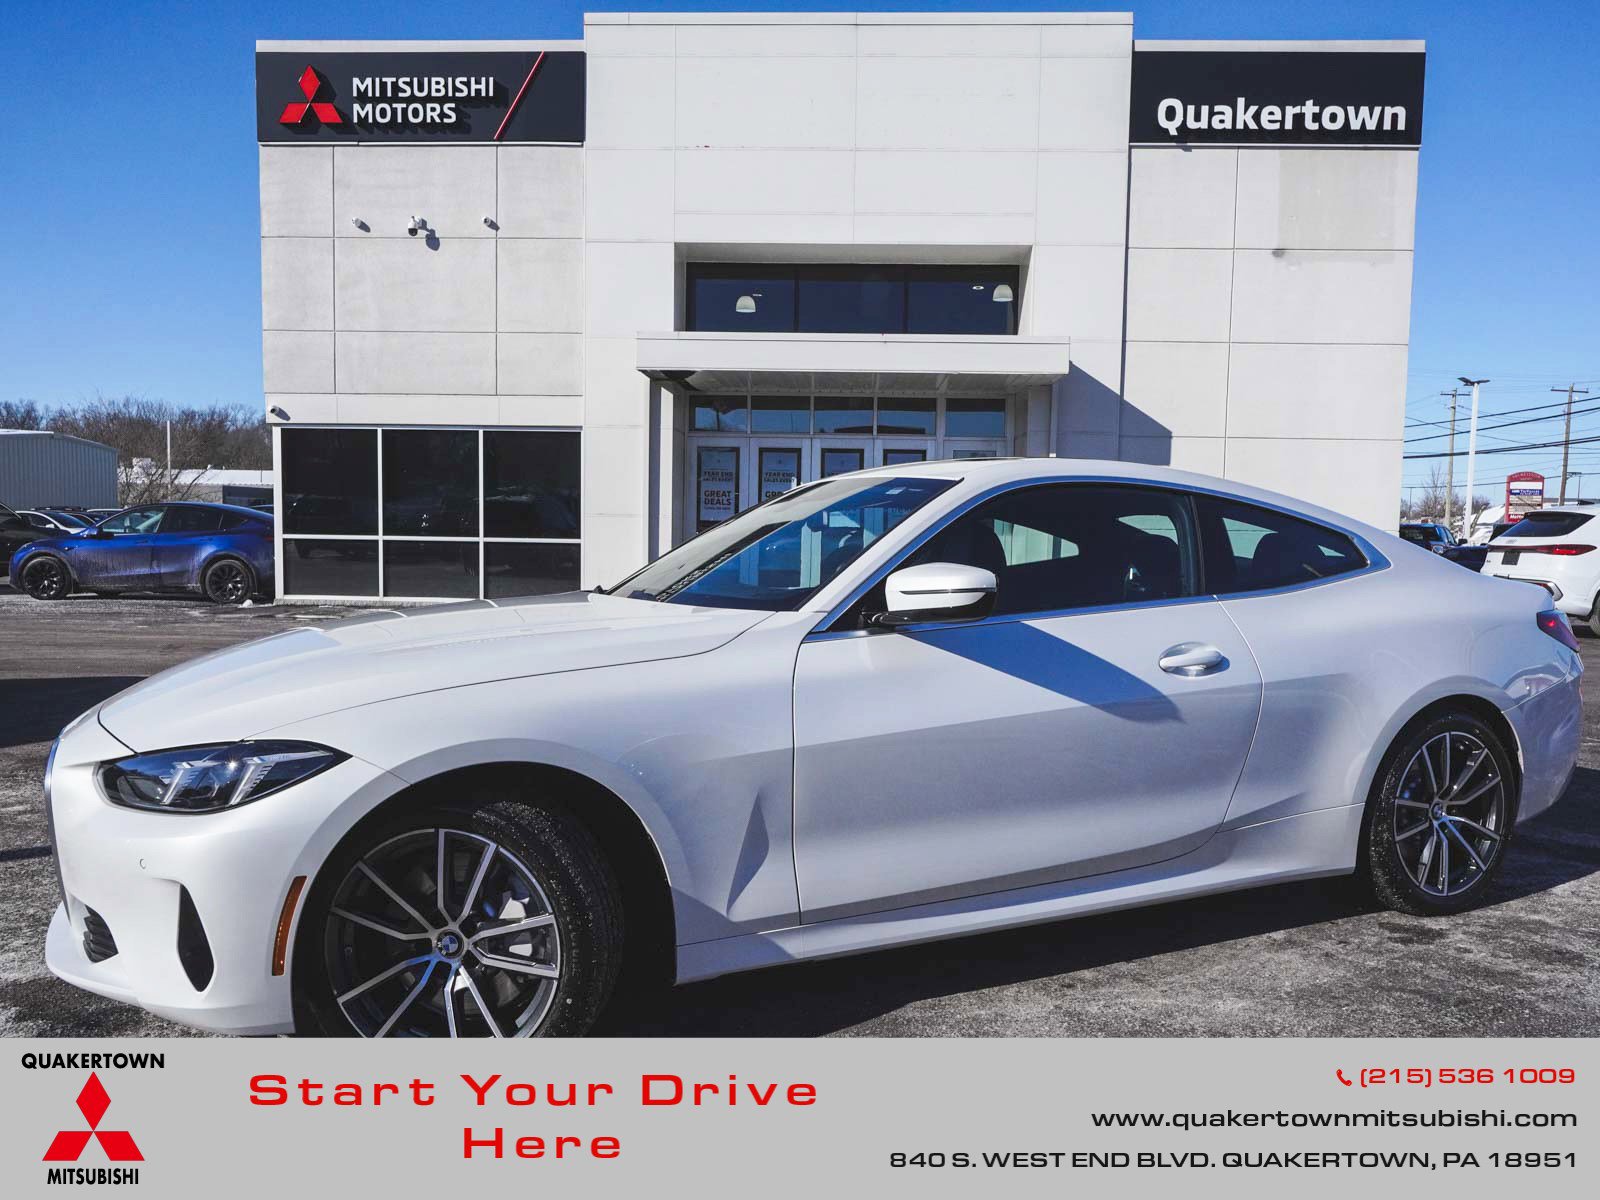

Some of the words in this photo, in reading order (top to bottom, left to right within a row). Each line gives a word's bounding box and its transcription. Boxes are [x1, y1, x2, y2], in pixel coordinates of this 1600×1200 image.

[352, 76, 495, 98] MITSUBISHI
[352, 102, 457, 125] MOTORS
[1156, 96, 1407, 136] Quakertown
[703, 490, 732, 498] GREAT
[703, 498, 732, 506] DEALS
